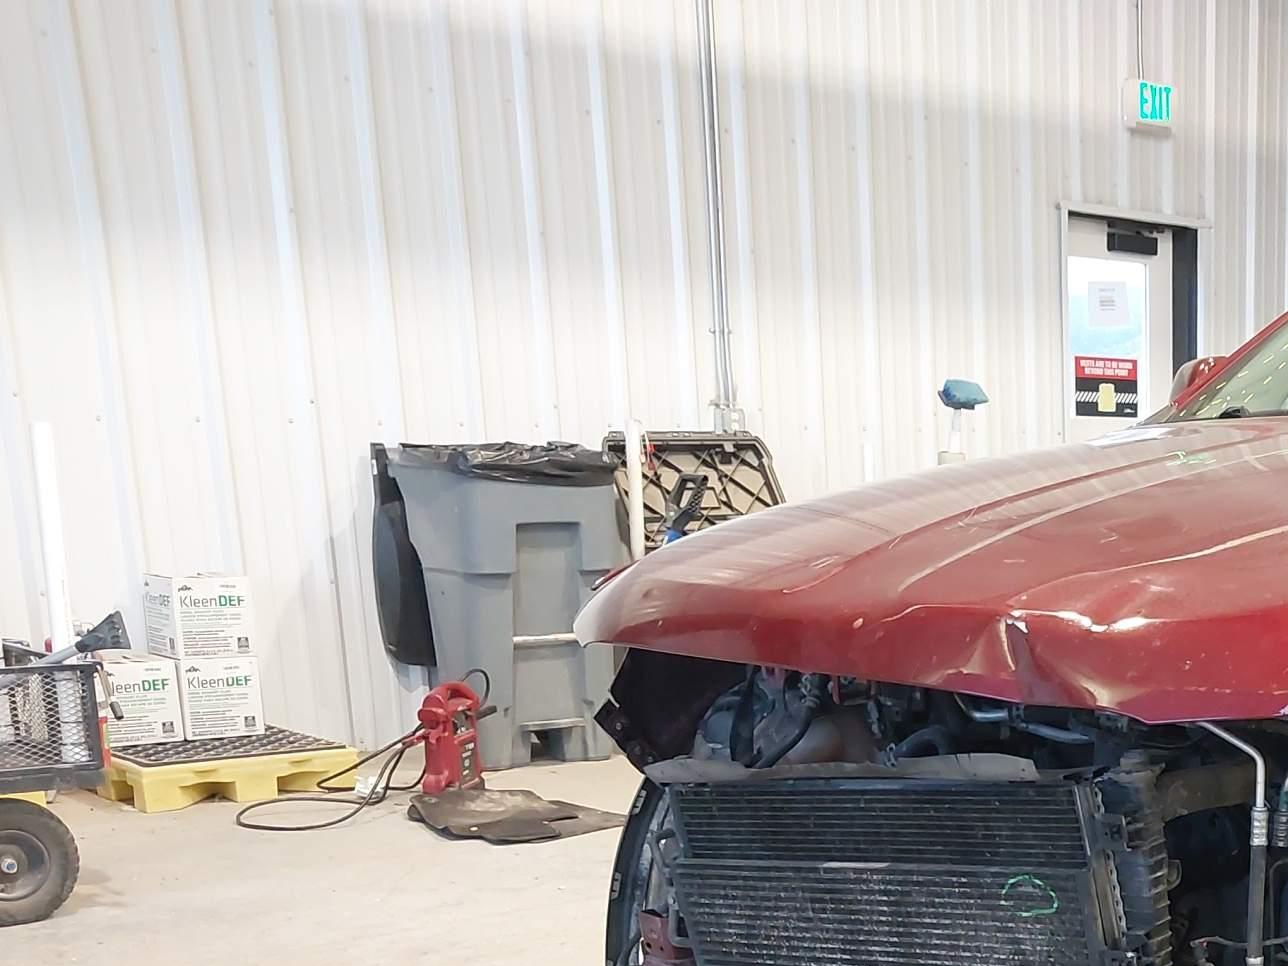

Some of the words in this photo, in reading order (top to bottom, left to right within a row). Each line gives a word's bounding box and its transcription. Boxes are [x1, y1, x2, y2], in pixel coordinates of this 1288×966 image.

[1140, 82, 1171, 121] EXIT
[179, 594, 246, 609] KleenDEF
[110, 677, 170, 695] leenDEF
[187, 675, 253, 690] KleenDEF
